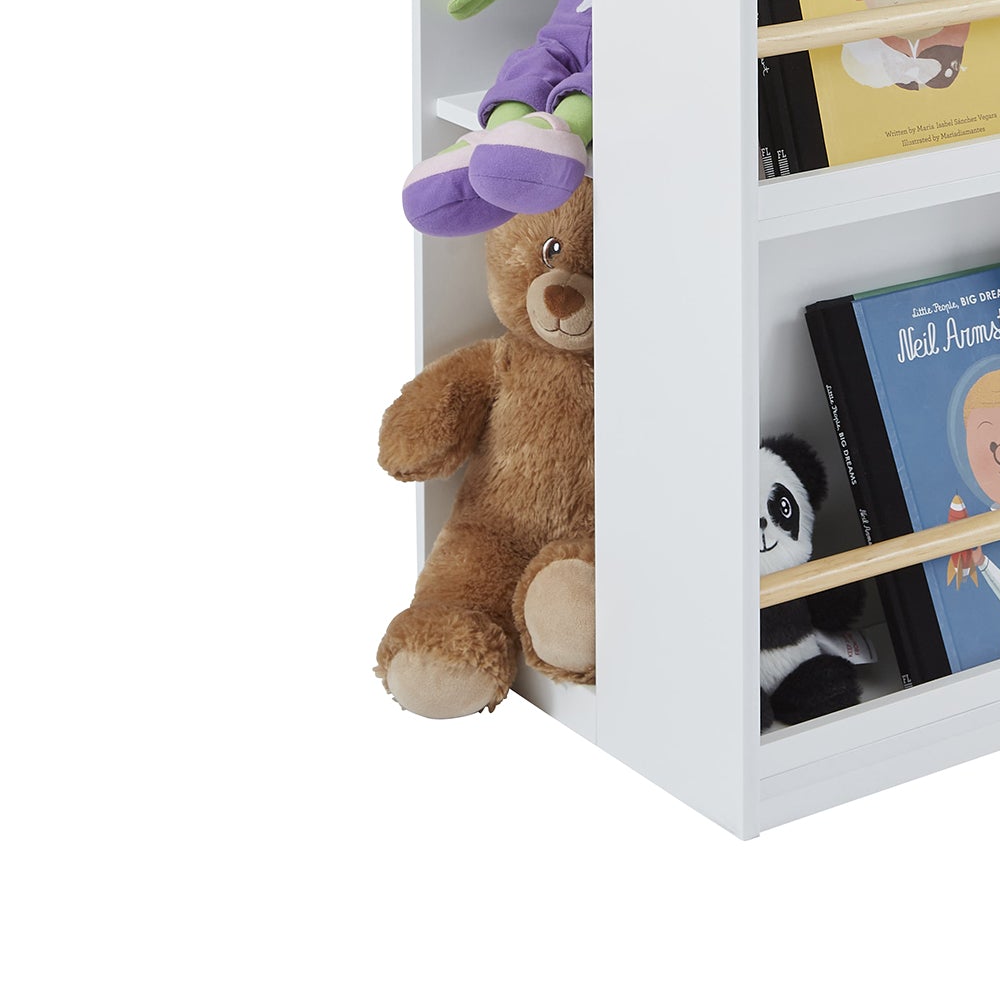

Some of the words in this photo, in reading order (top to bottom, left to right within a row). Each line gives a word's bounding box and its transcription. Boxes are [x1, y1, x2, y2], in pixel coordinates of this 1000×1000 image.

[885, 129, 909, 137] Written
[908, 126, 916, 135] by
[936, 119, 954, 129] Isabel
[902, 134, 932, 147] Illustrated
[932, 133, 941, 142] by
[912, 306, 933, 318] Little
[932, 300, 959, 315] People,
[959, 294, 977, 307] BIG
[897, 322, 940, 363] Neil
[825, 384, 834, 406] Little
[838, 431, 847, 448] BIG
[843, 449, 857, 486] DREAMS
